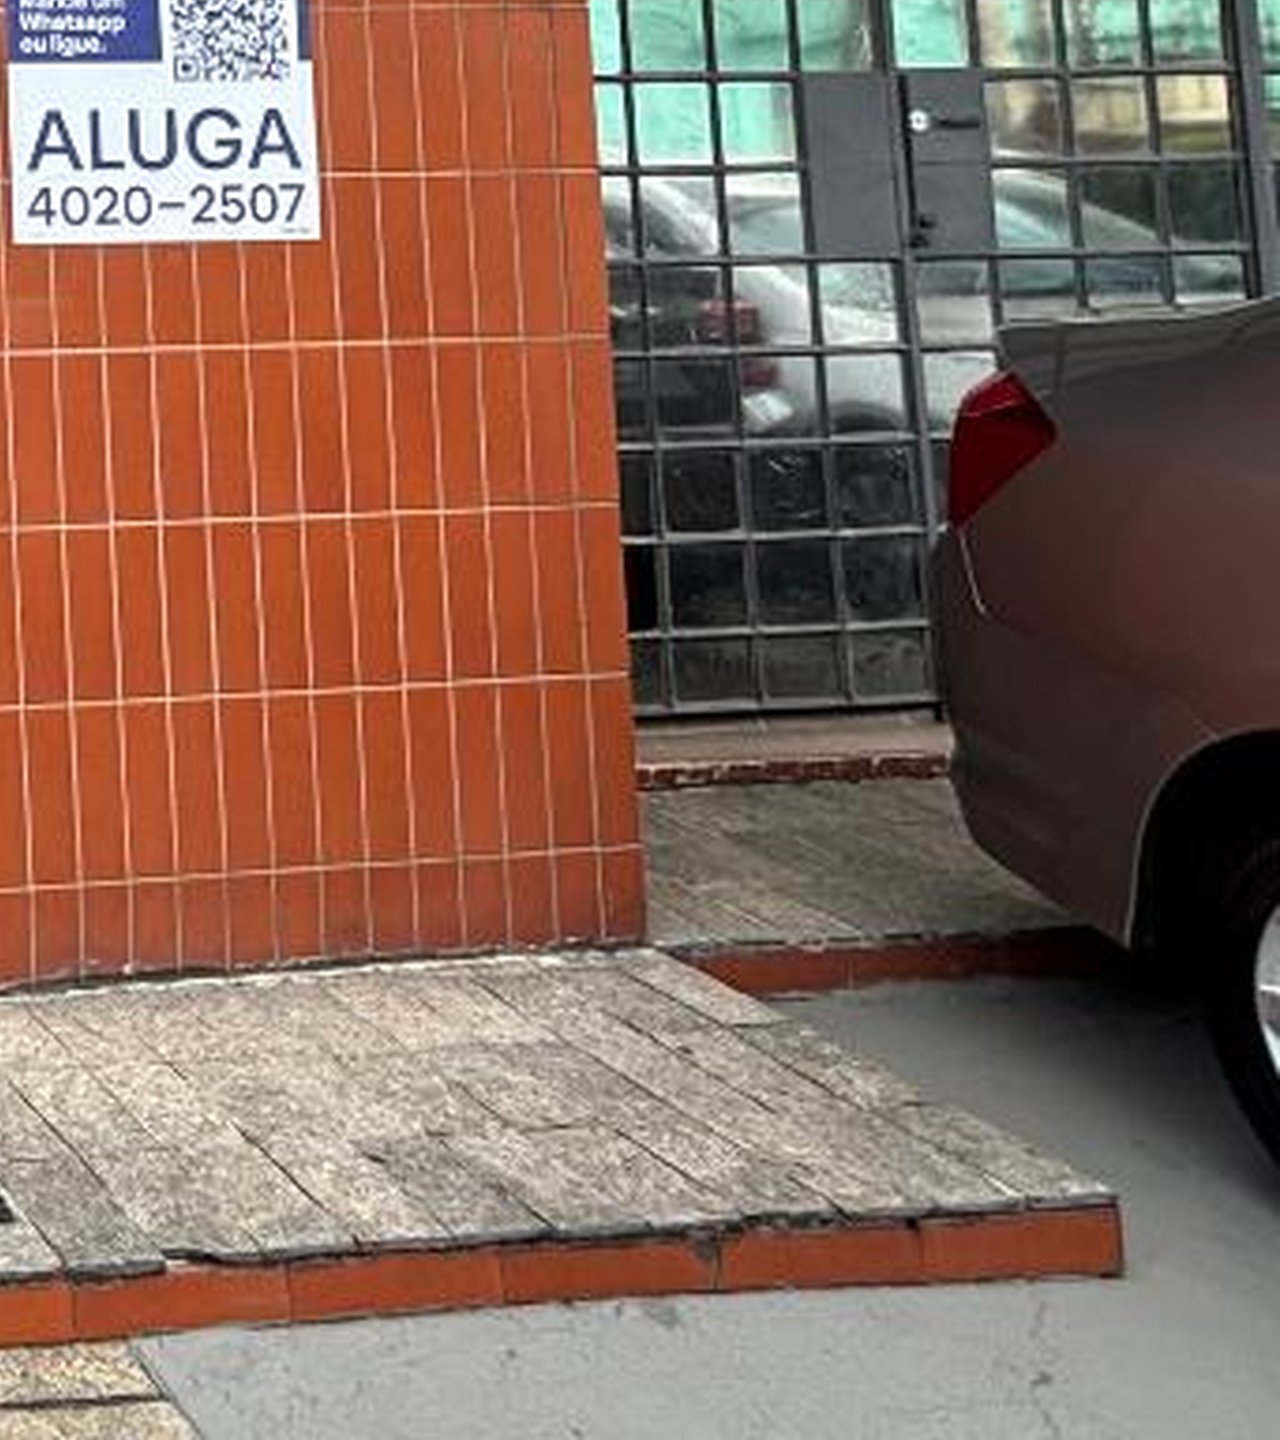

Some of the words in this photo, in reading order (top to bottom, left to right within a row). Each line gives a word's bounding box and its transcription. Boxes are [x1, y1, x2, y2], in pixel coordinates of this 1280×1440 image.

[19, 35, 47, 54] ou
[27, 108, 302, 171] ALUGA
[27, 184, 306, 226] 4020-2507
